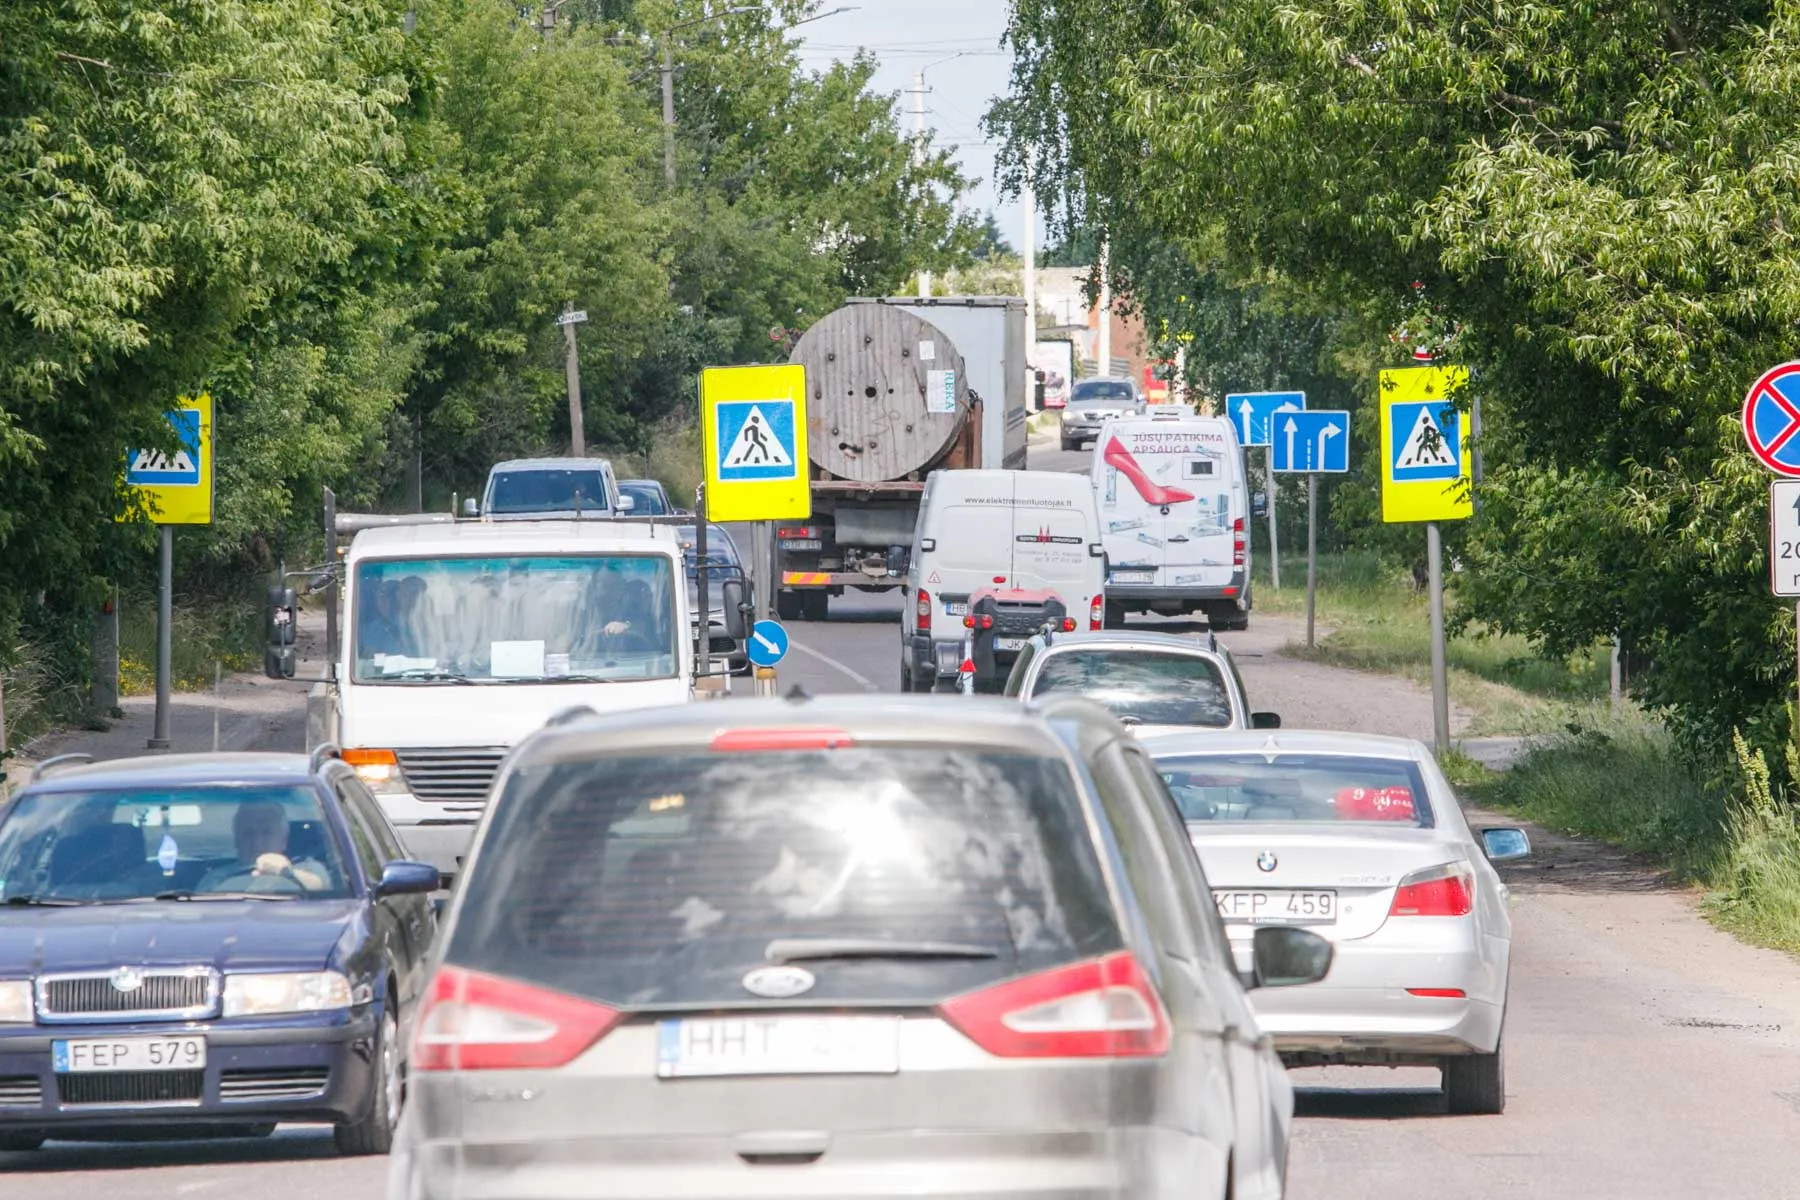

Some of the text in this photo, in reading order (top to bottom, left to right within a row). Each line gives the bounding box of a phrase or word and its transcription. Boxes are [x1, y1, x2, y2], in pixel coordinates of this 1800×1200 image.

[1166, 433, 1224, 442] PATIKIMA
[1133, 445, 1190, 454] APSAUGA
[1214, 893, 1331, 914] KFP 459
[689, 1019, 779, 1056] HHT
[73, 1041, 199, 1067] FEP 579
